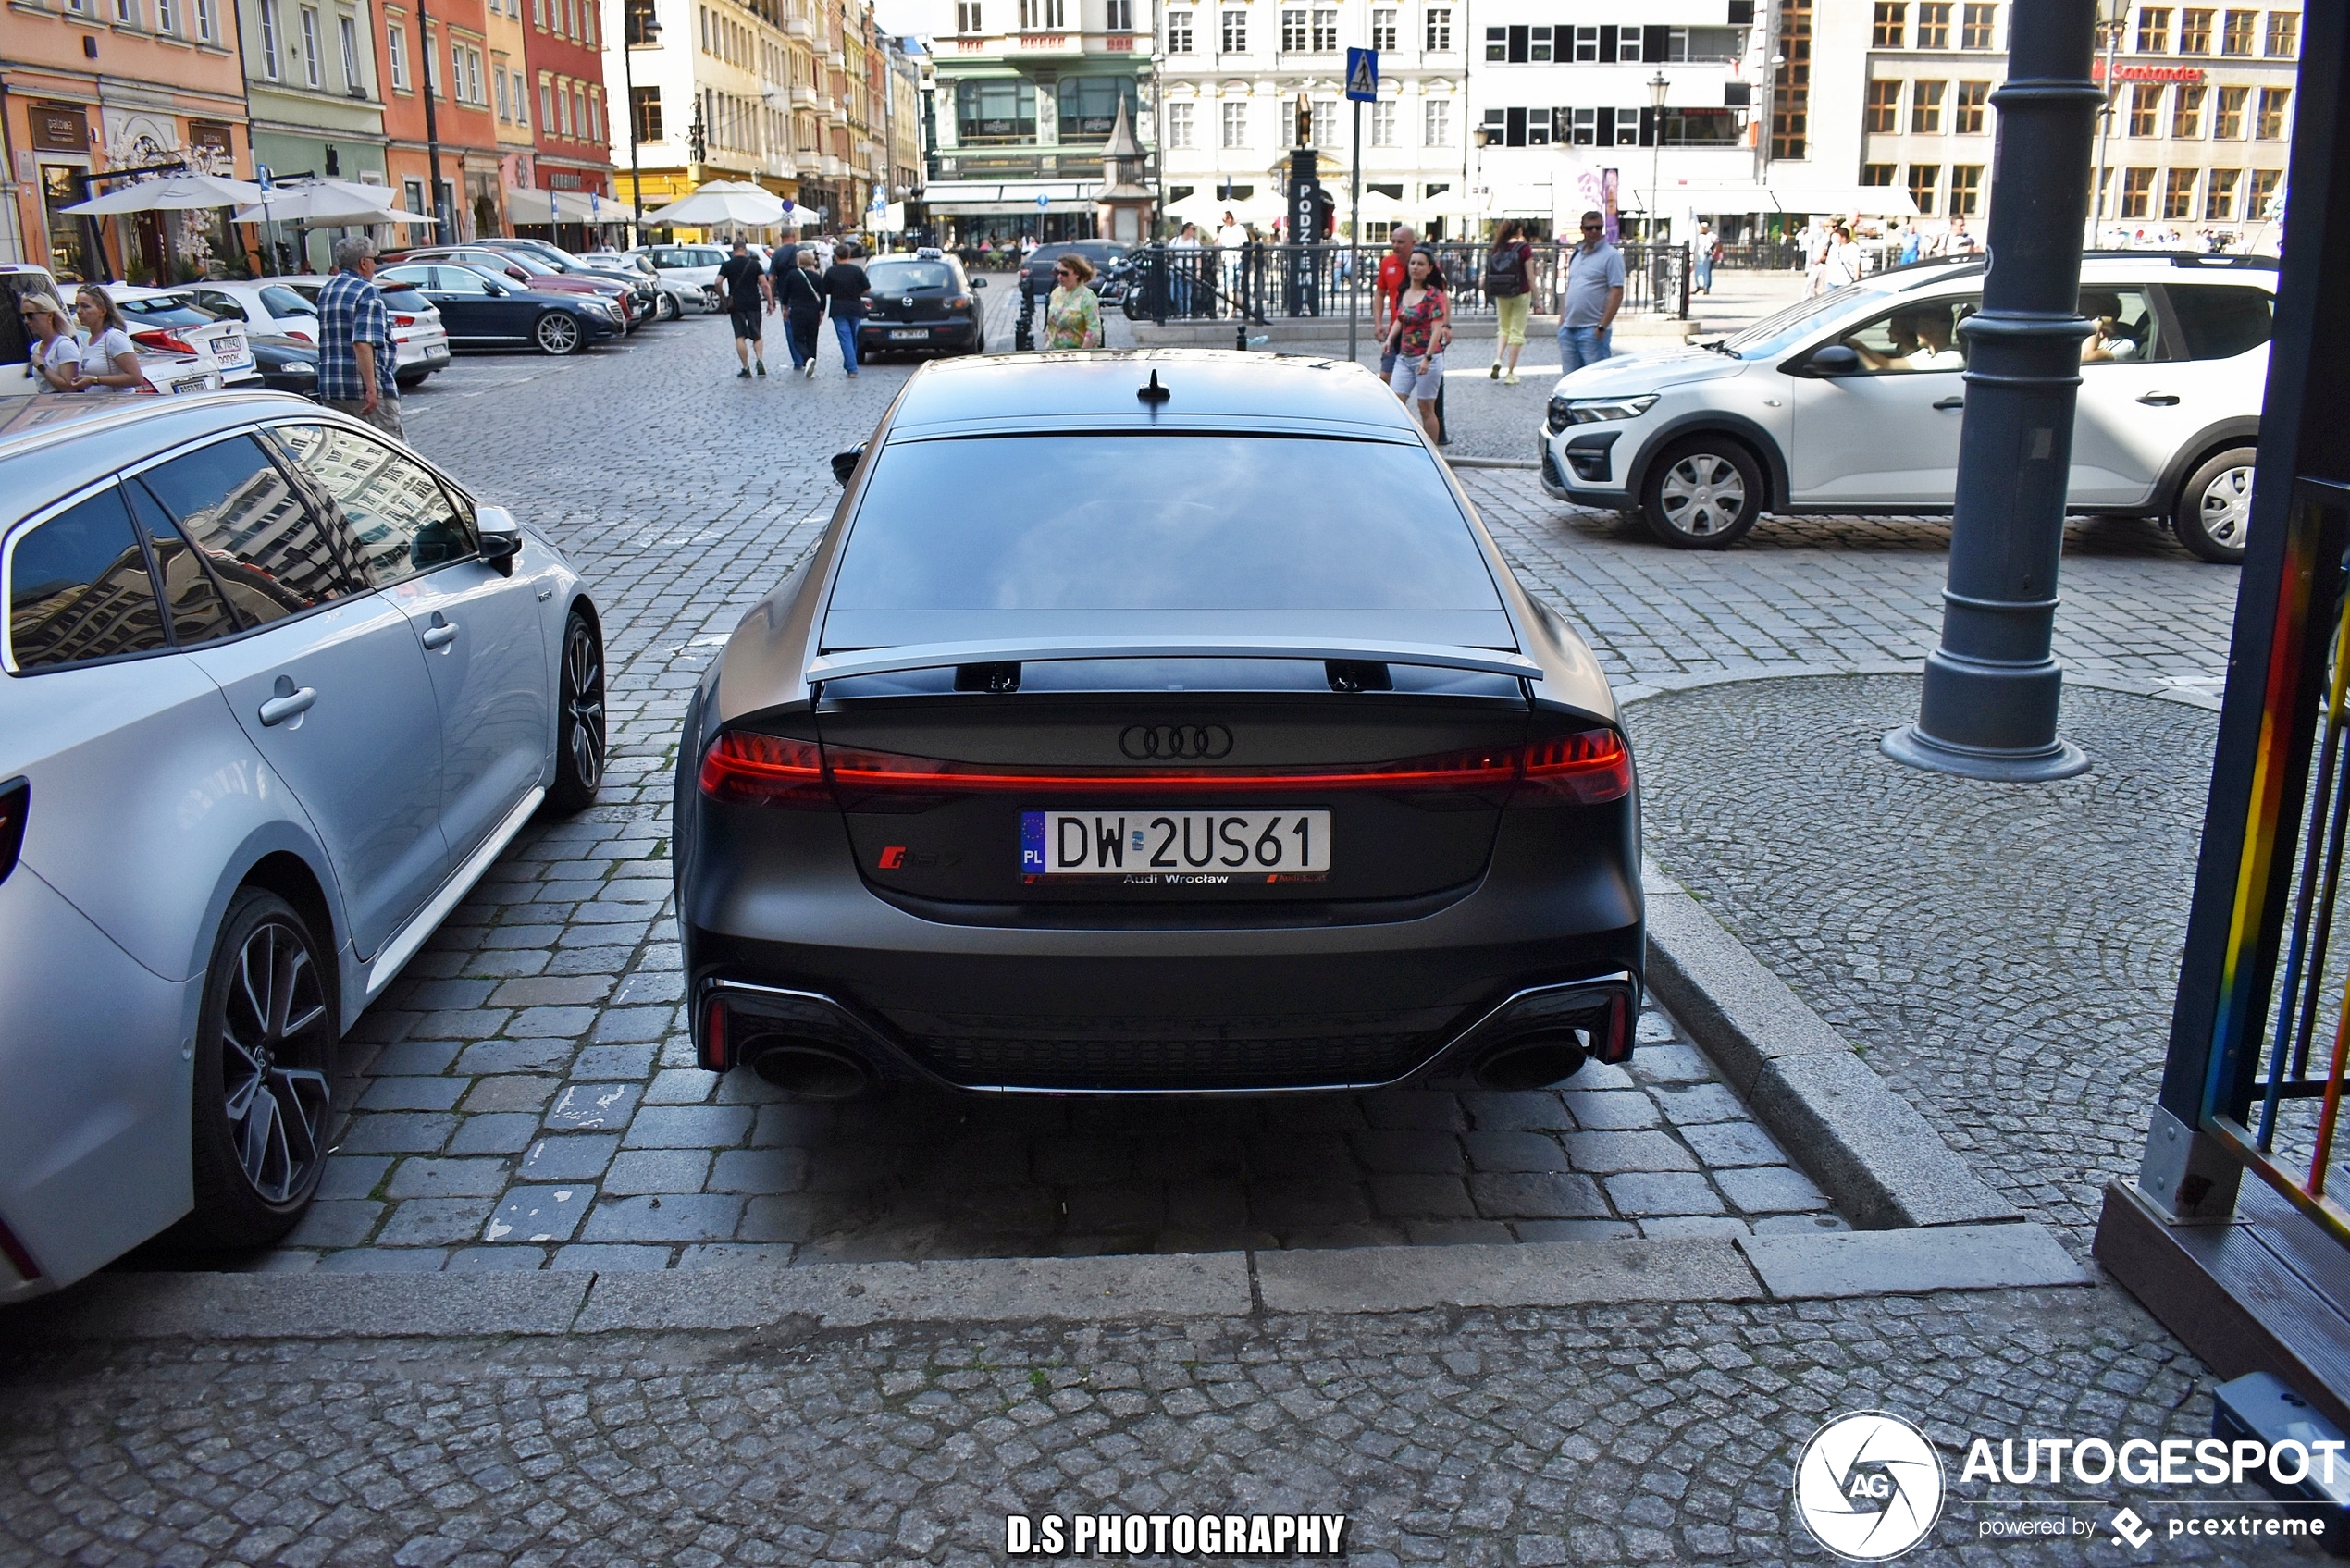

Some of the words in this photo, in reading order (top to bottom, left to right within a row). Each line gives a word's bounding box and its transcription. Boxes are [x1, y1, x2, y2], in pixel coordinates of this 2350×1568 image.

[2111, 62, 2204, 81] Santander
[1058, 816, 1125, 868] DW
[1149, 816, 1308, 868] 2US61
[1023, 850, 1042, 864] PL
[1123, 873, 1158, 884] Audi
[1165, 873, 1229, 884] Wrocław
